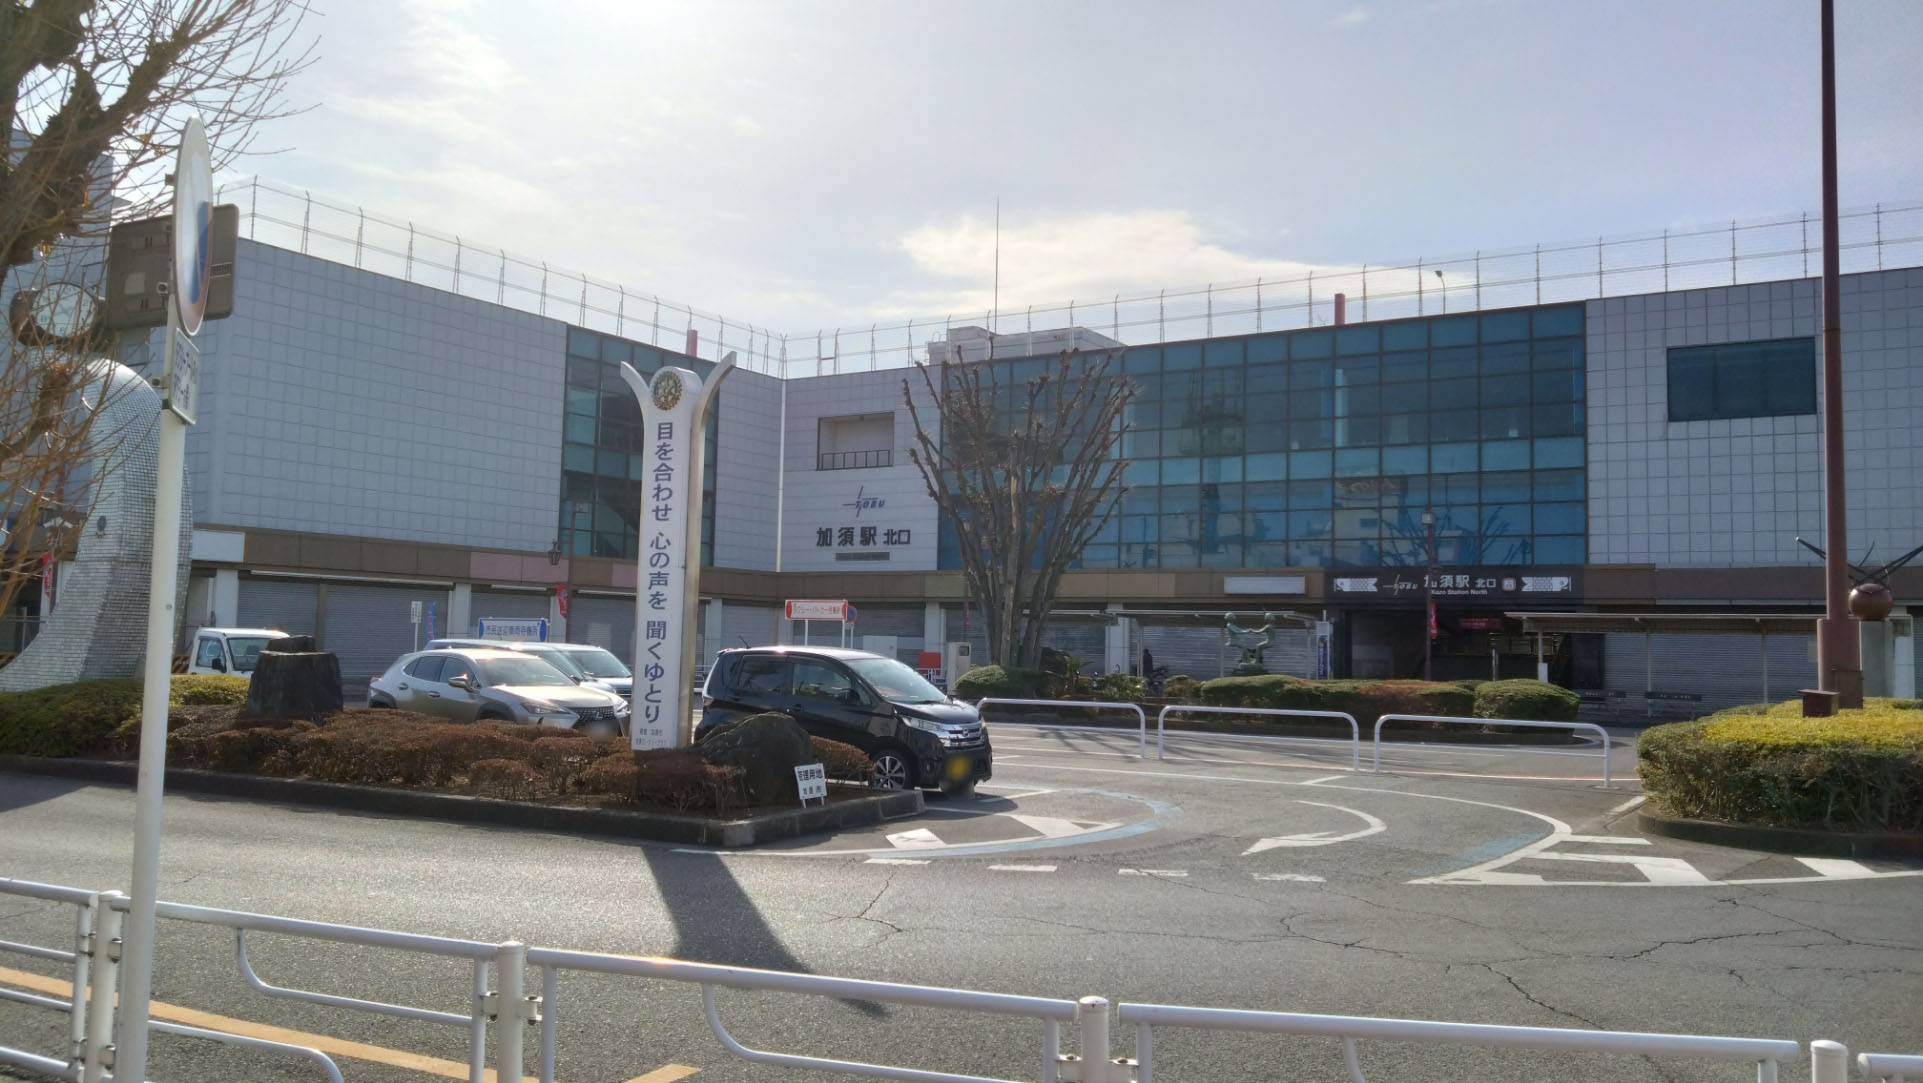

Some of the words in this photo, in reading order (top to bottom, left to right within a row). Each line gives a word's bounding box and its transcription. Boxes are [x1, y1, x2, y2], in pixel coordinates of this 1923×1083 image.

[651, 421, 674, 522] 目を合わせ
[647, 532, 672, 610] 心の声を
[816, 526, 877, 547] 加須駅
[883, 528, 911, 545] 北口
[1475, 578, 1496, 588] 北口
[644, 620, 667, 723] 聞くゆとり
